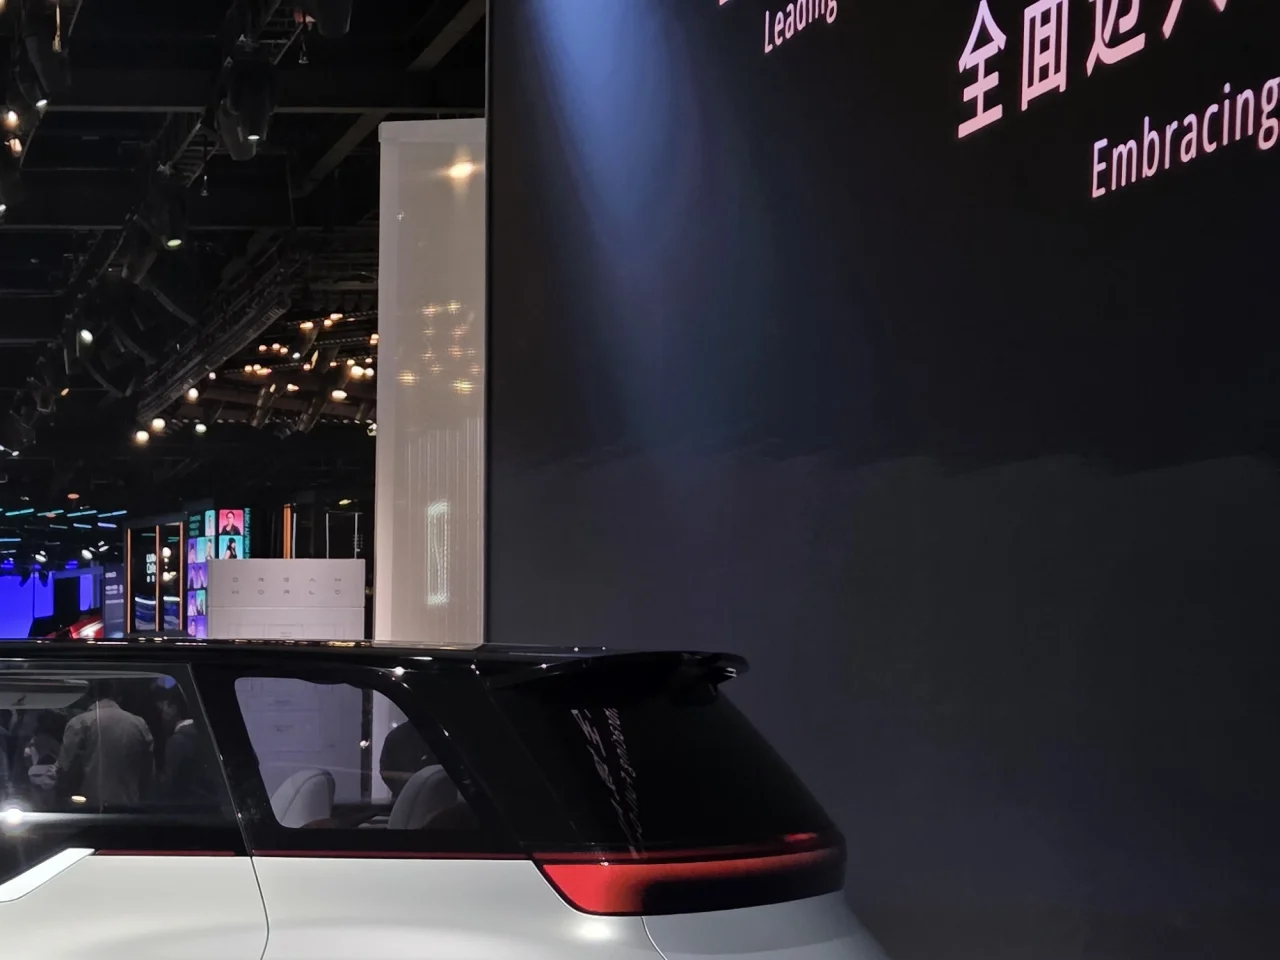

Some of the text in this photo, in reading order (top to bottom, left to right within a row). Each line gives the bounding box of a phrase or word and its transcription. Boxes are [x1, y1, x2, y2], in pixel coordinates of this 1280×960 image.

[764, 0, 838, 54] Leading
[958, 0, 1230, 140] 全面迈
[1091, 76, 1280, 199] Embracing
